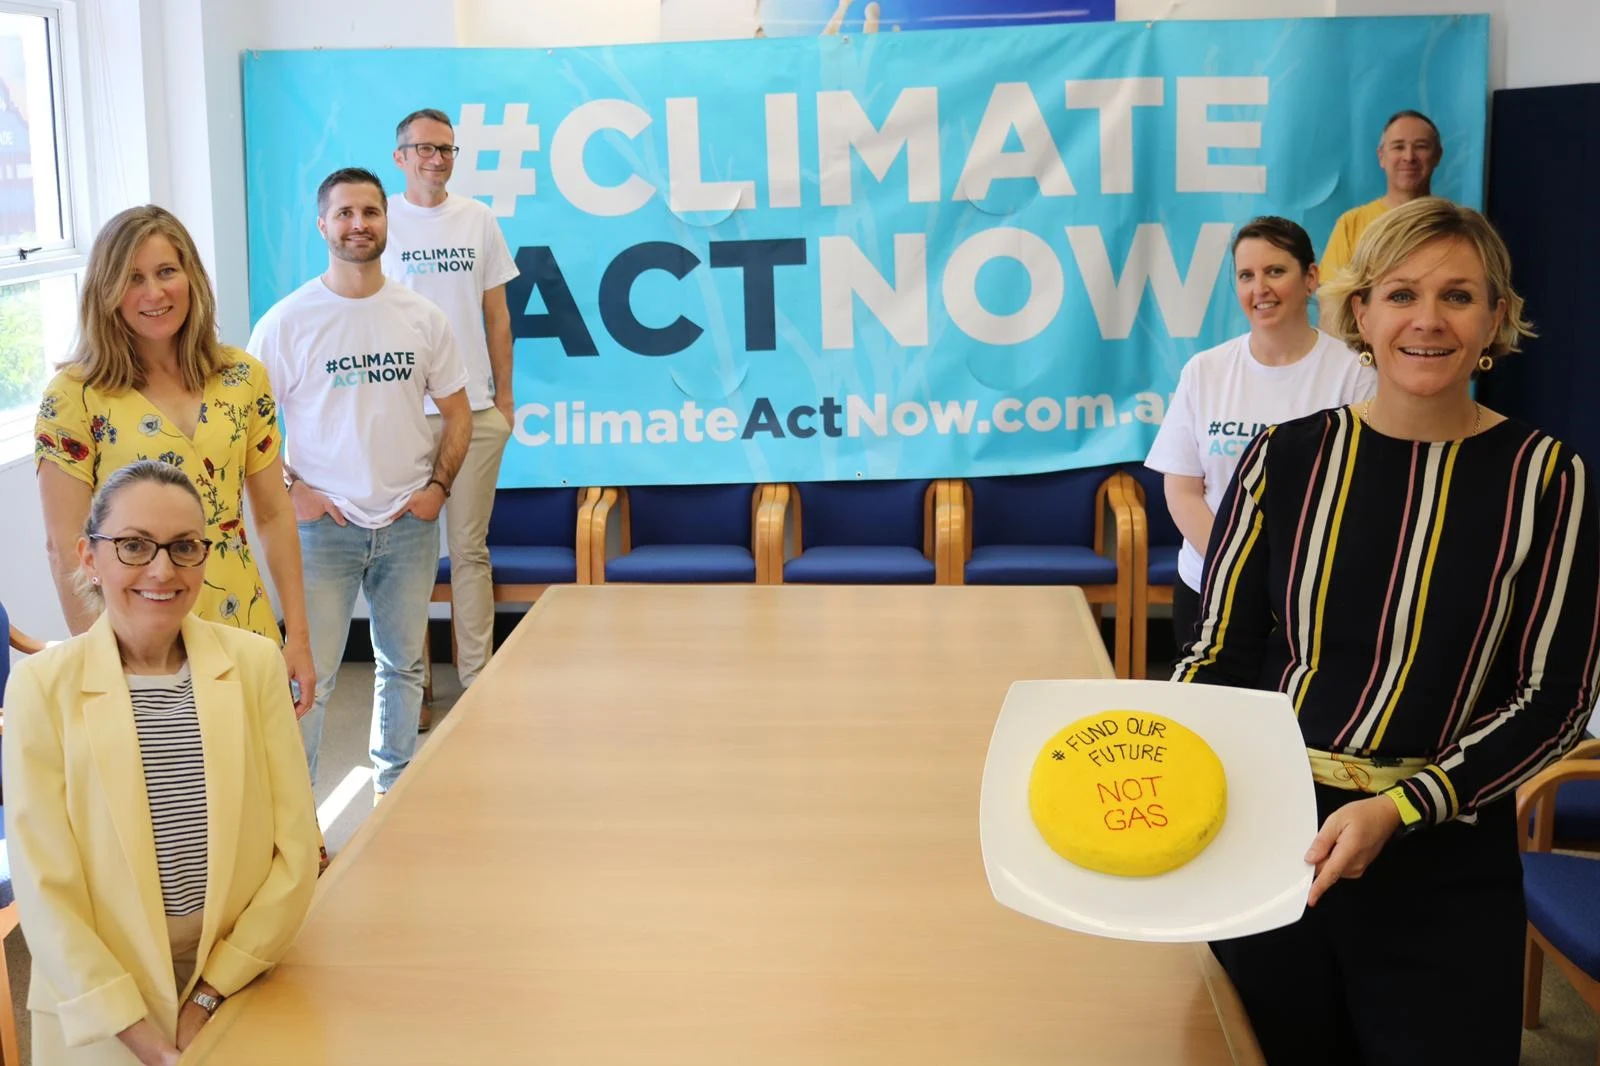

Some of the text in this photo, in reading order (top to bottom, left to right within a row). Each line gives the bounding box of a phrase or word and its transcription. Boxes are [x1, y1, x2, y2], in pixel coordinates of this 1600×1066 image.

[455, 76, 1268, 217] #CLIMATE
[400, 248, 475, 262] #CLIMATE
[406, 260, 474, 275] ACTNOW
[507, 223, 1233, 357] ACTNOW
[325, 352, 415, 374] #CLIMATE
[332, 367, 413, 388] ACTNOW
[513, 391, 1176, 448] ClimateActNow.com.a
[1208, 420, 1268, 437] #CLI
[1065, 719, 1118, 752] FUND
[1126, 717, 1166, 738] OUR
[1088, 743, 1168, 767] FUTURE
[1096, 775, 1162, 804] NOT
[1104, 804, 1168, 830] GAS
